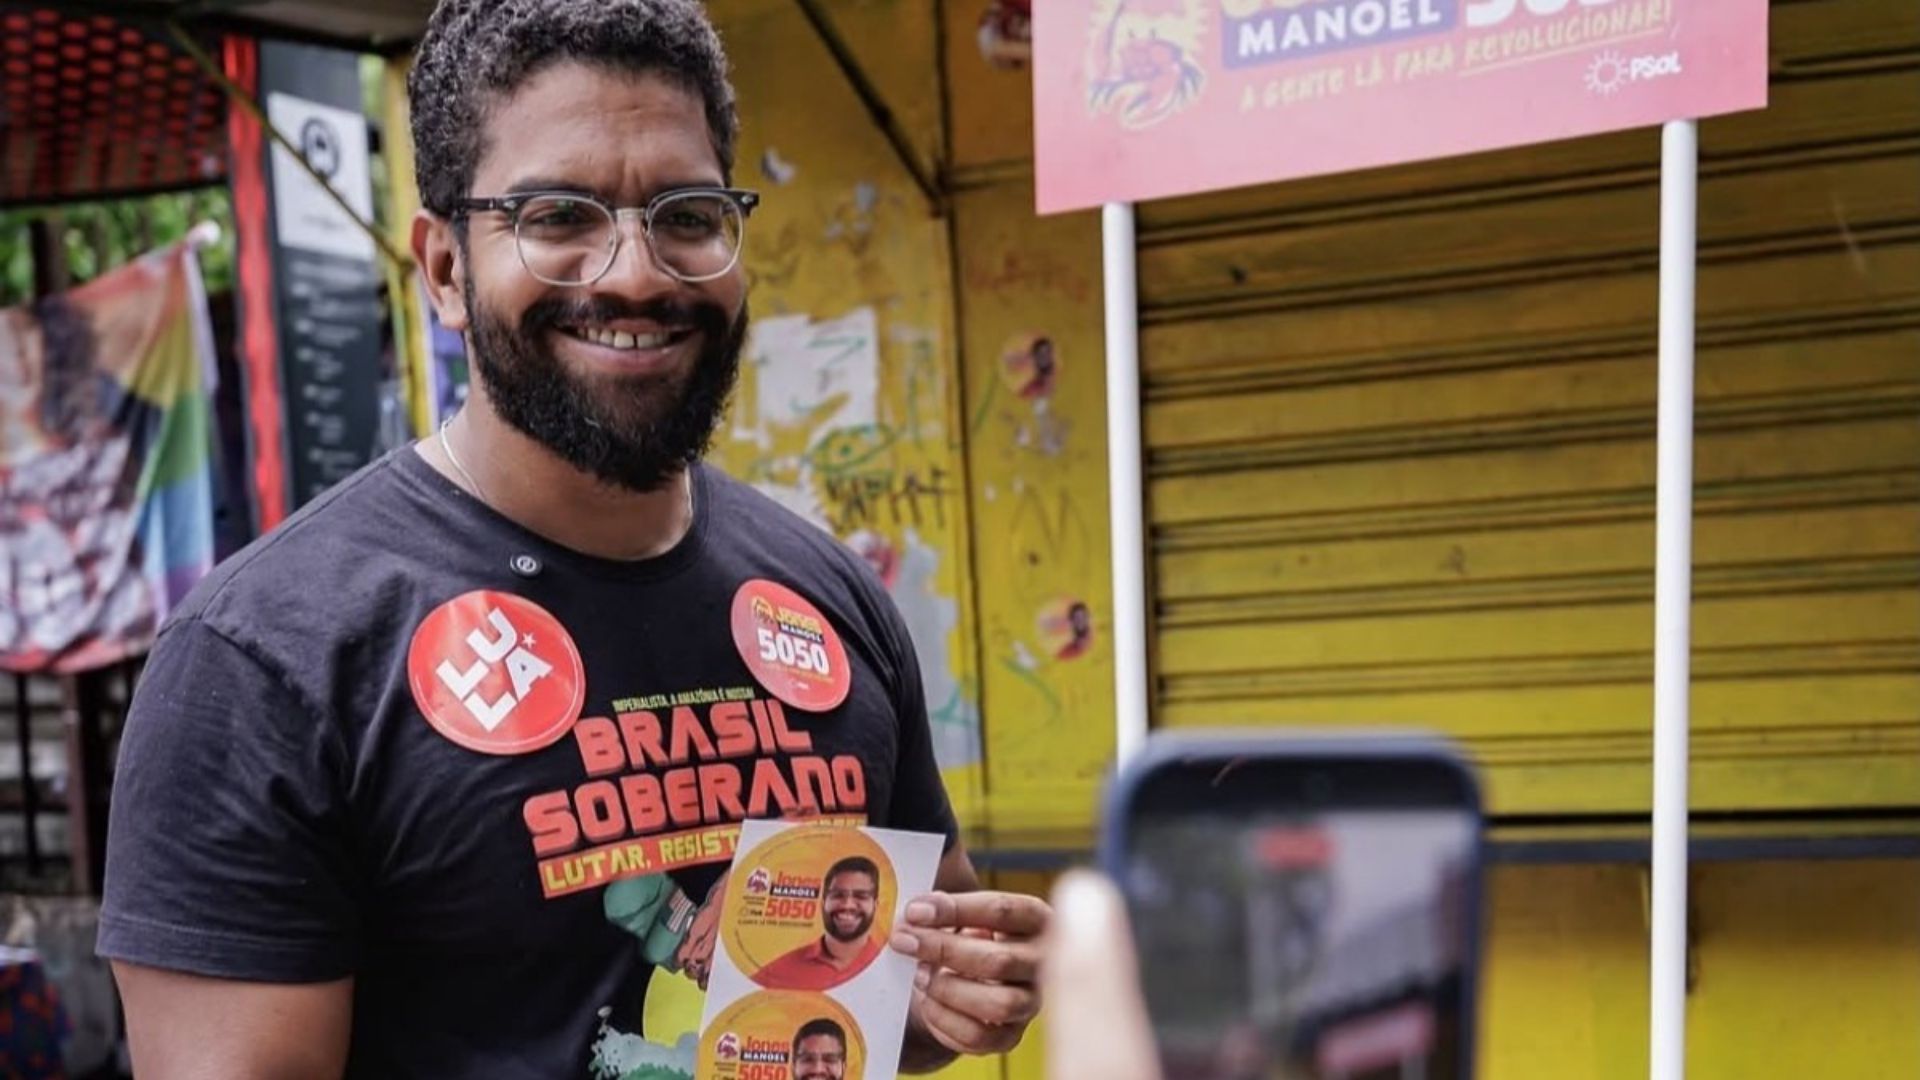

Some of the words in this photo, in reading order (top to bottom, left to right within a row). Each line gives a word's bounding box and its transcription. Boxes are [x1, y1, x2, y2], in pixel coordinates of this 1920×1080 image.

[1238, 0, 1441, 57] MANOEL
[757, 626, 830, 675] 5050
[574, 699, 812, 777] BRASIL
[523, 755, 867, 857] SOBERANO
[545, 844, 651, 890] LUTAR,
[659, 828, 740, 864] RESIST
[765, 899, 817, 919] 5050
[738, 1064, 788, 1080] 5050
